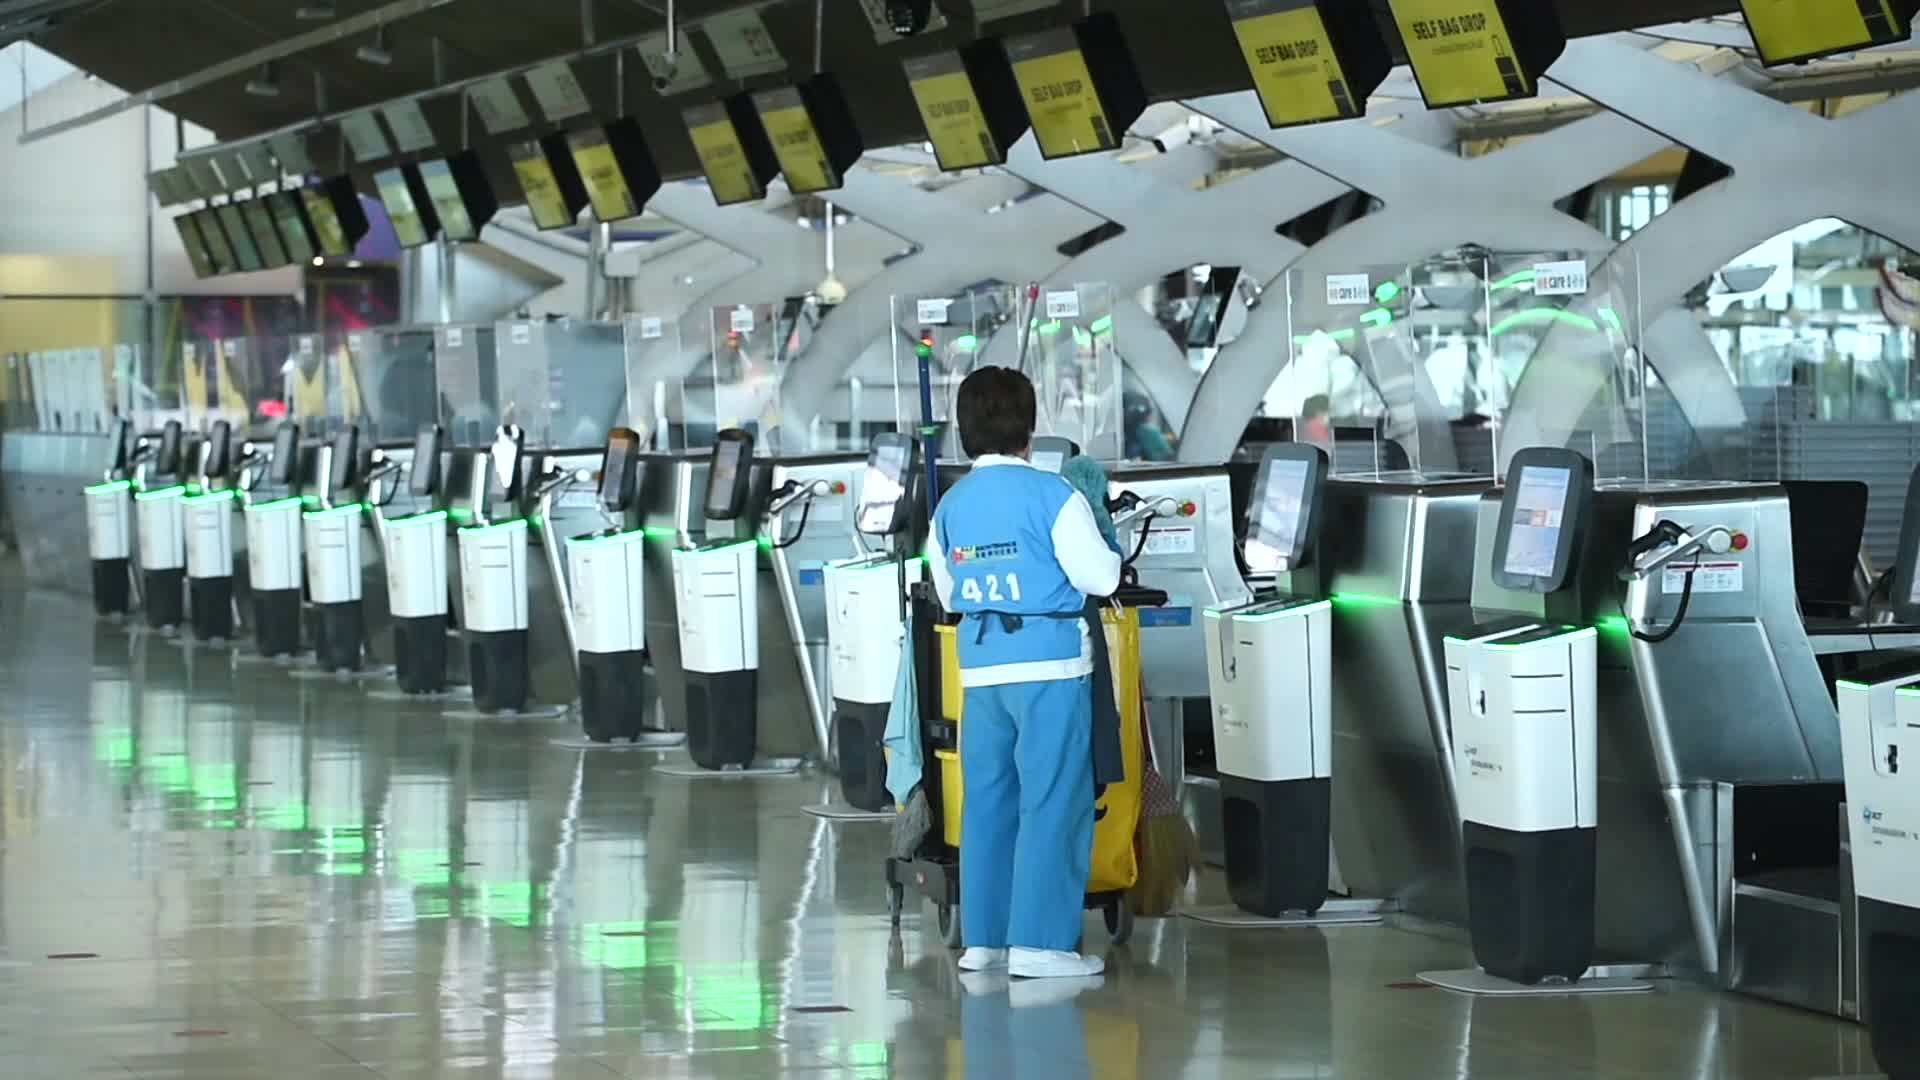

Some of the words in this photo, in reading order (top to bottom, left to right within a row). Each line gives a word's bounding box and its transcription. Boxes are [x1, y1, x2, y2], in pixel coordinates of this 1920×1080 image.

[1412, 21, 1437, 40] SELF
[1438, 17, 1460, 36] BAG
[1459, 12, 1486, 33] DROP
[1256, 46, 1277, 64] SELF
[1276, 43, 1296, 61] BAG
[1294, 39, 1319, 58] DROP
[961, 573, 1020, 602] 421
